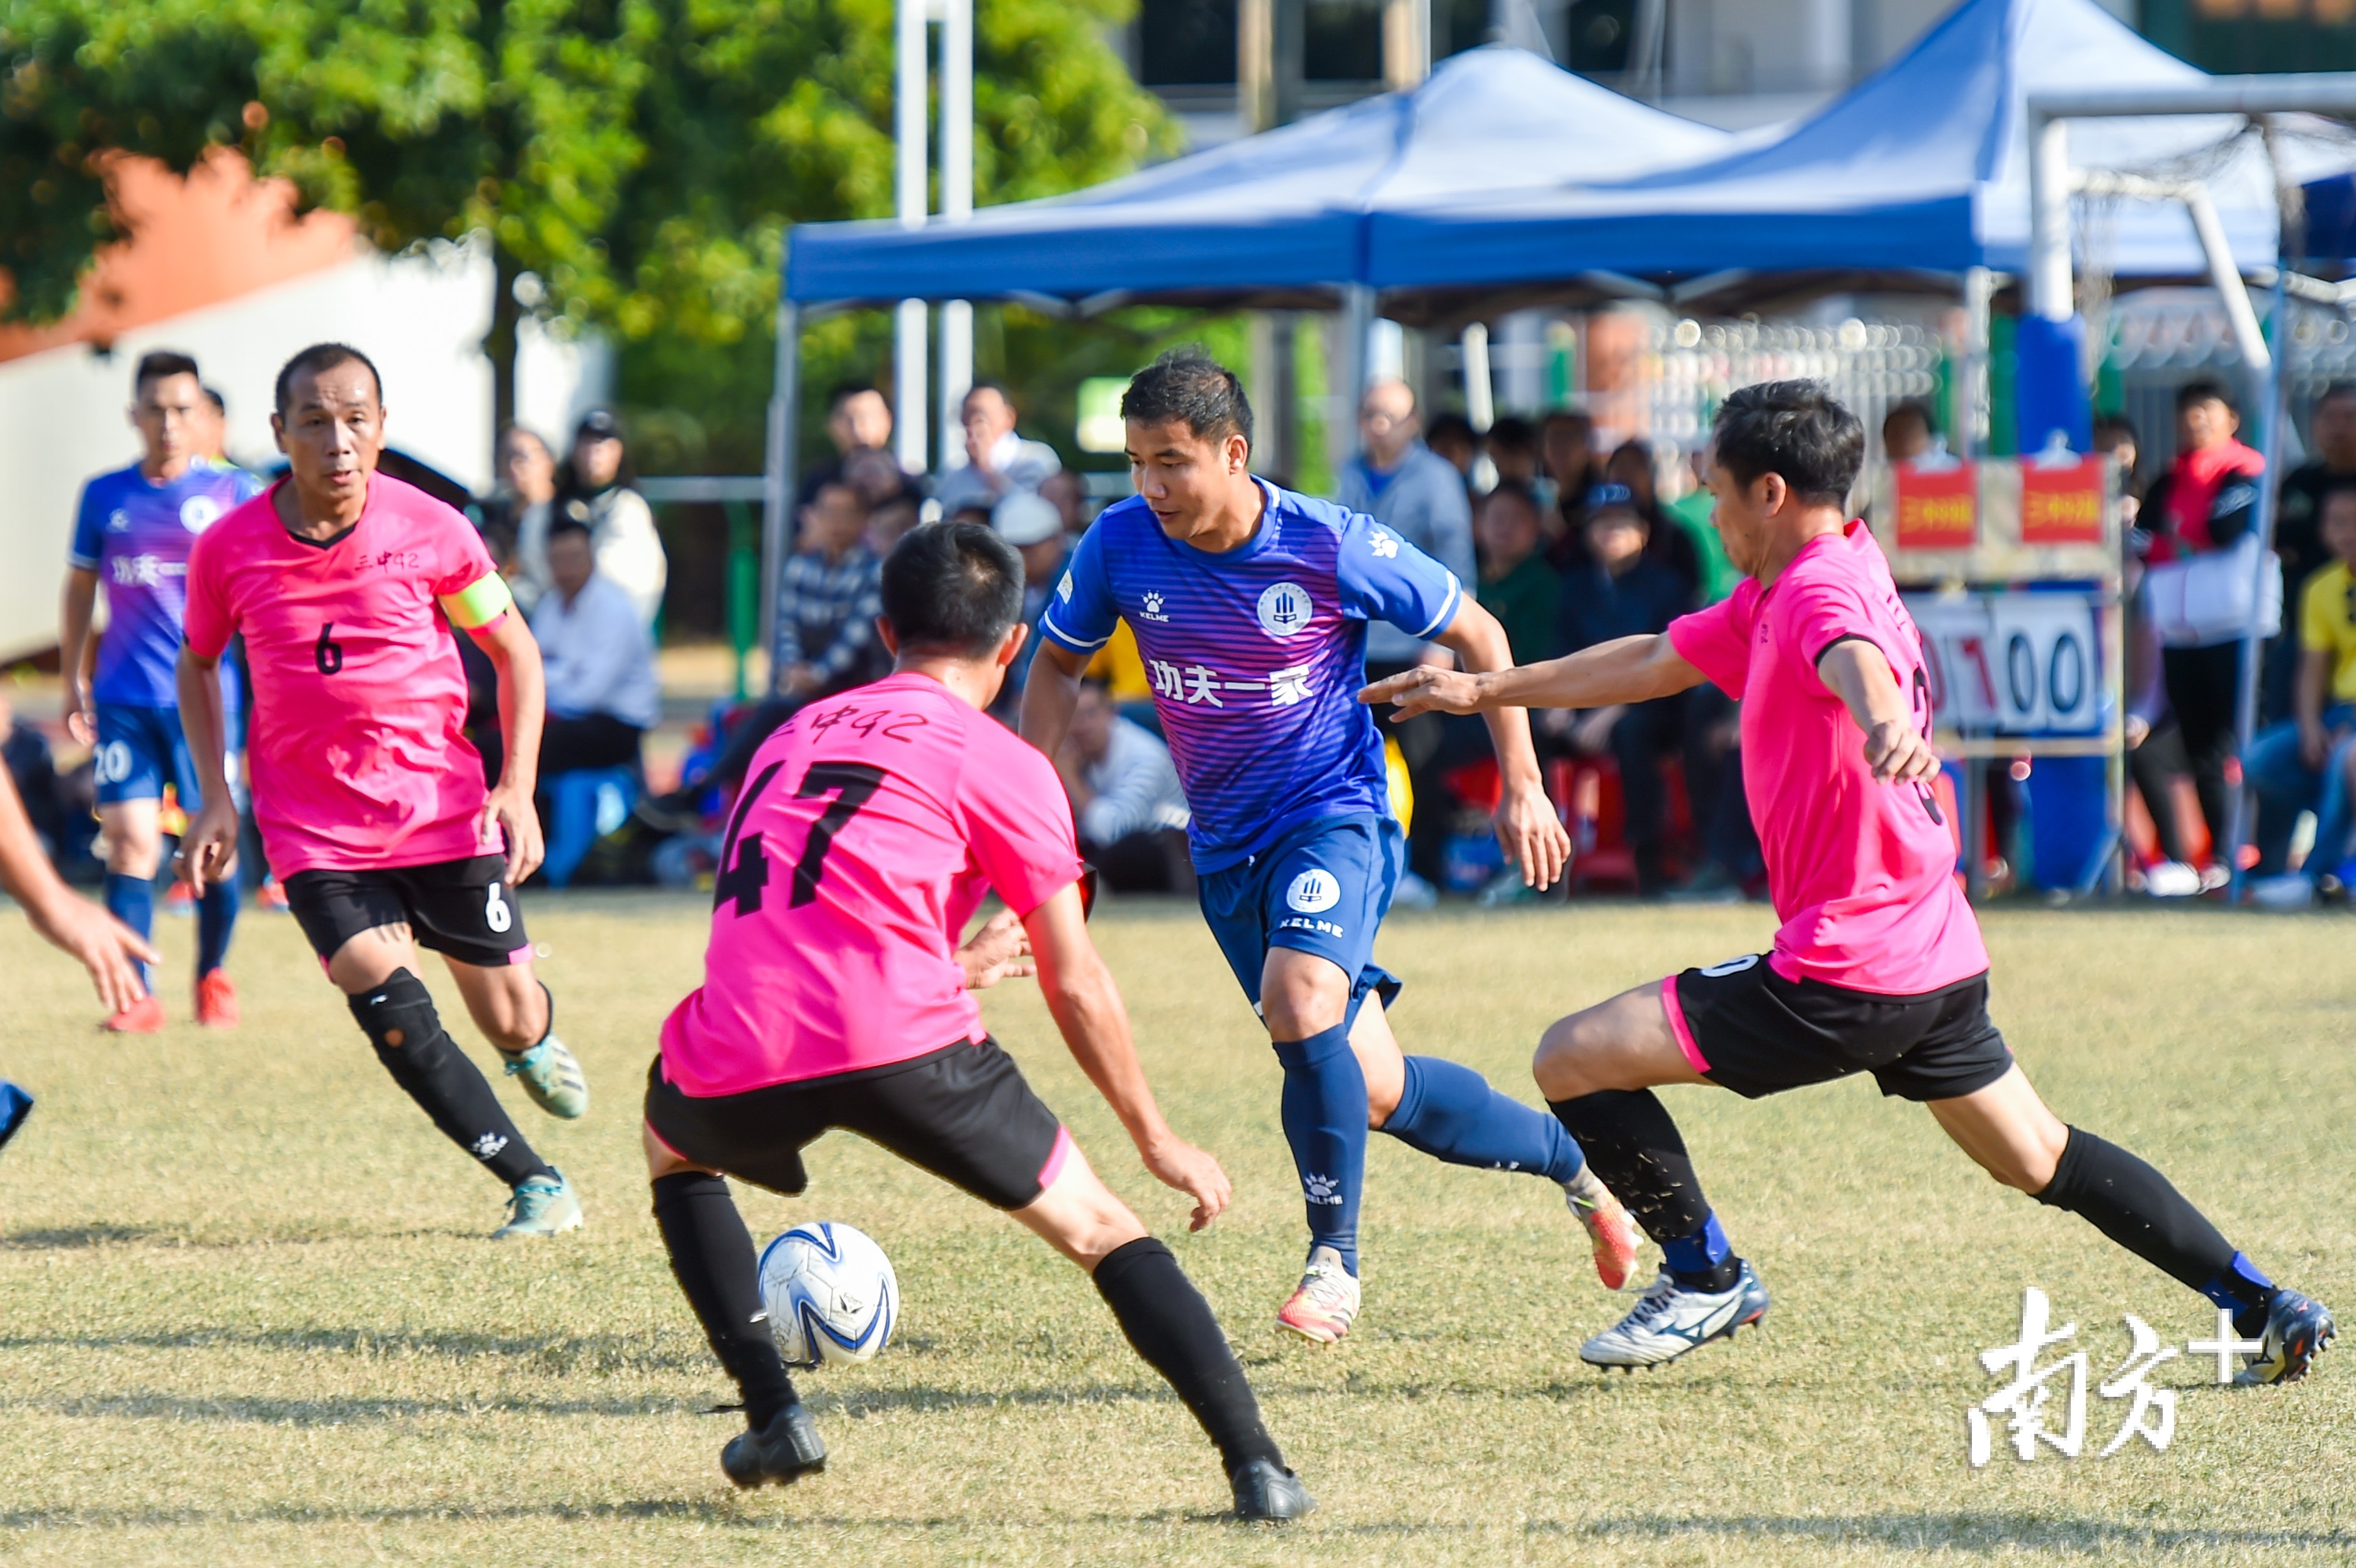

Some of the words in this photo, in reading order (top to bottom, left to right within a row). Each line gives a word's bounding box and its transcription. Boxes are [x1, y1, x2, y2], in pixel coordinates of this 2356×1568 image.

[1140, 611, 1169, 623] KELME
[317, 622, 343, 675] 6
[1148, 660, 1313, 708] 功夫一家
[713, 760, 890, 919] 47
[485, 882, 511, 933] 6
